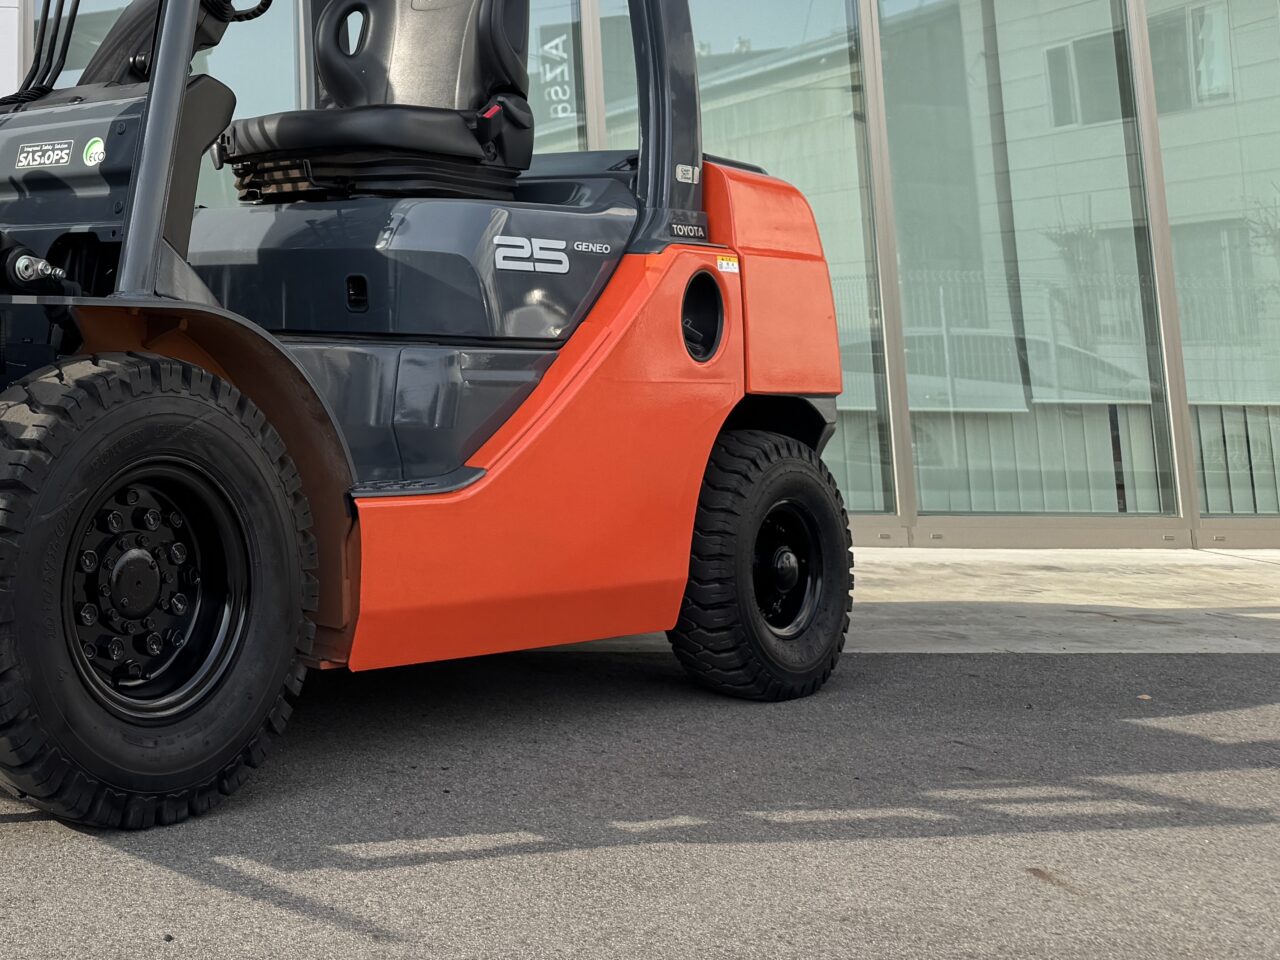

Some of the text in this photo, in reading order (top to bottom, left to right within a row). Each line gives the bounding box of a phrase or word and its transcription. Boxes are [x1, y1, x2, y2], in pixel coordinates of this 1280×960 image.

[672, 224, 705, 237] TOYOTA
[573, 241, 611, 254] GENEO
[493, 235, 570, 274] 25
